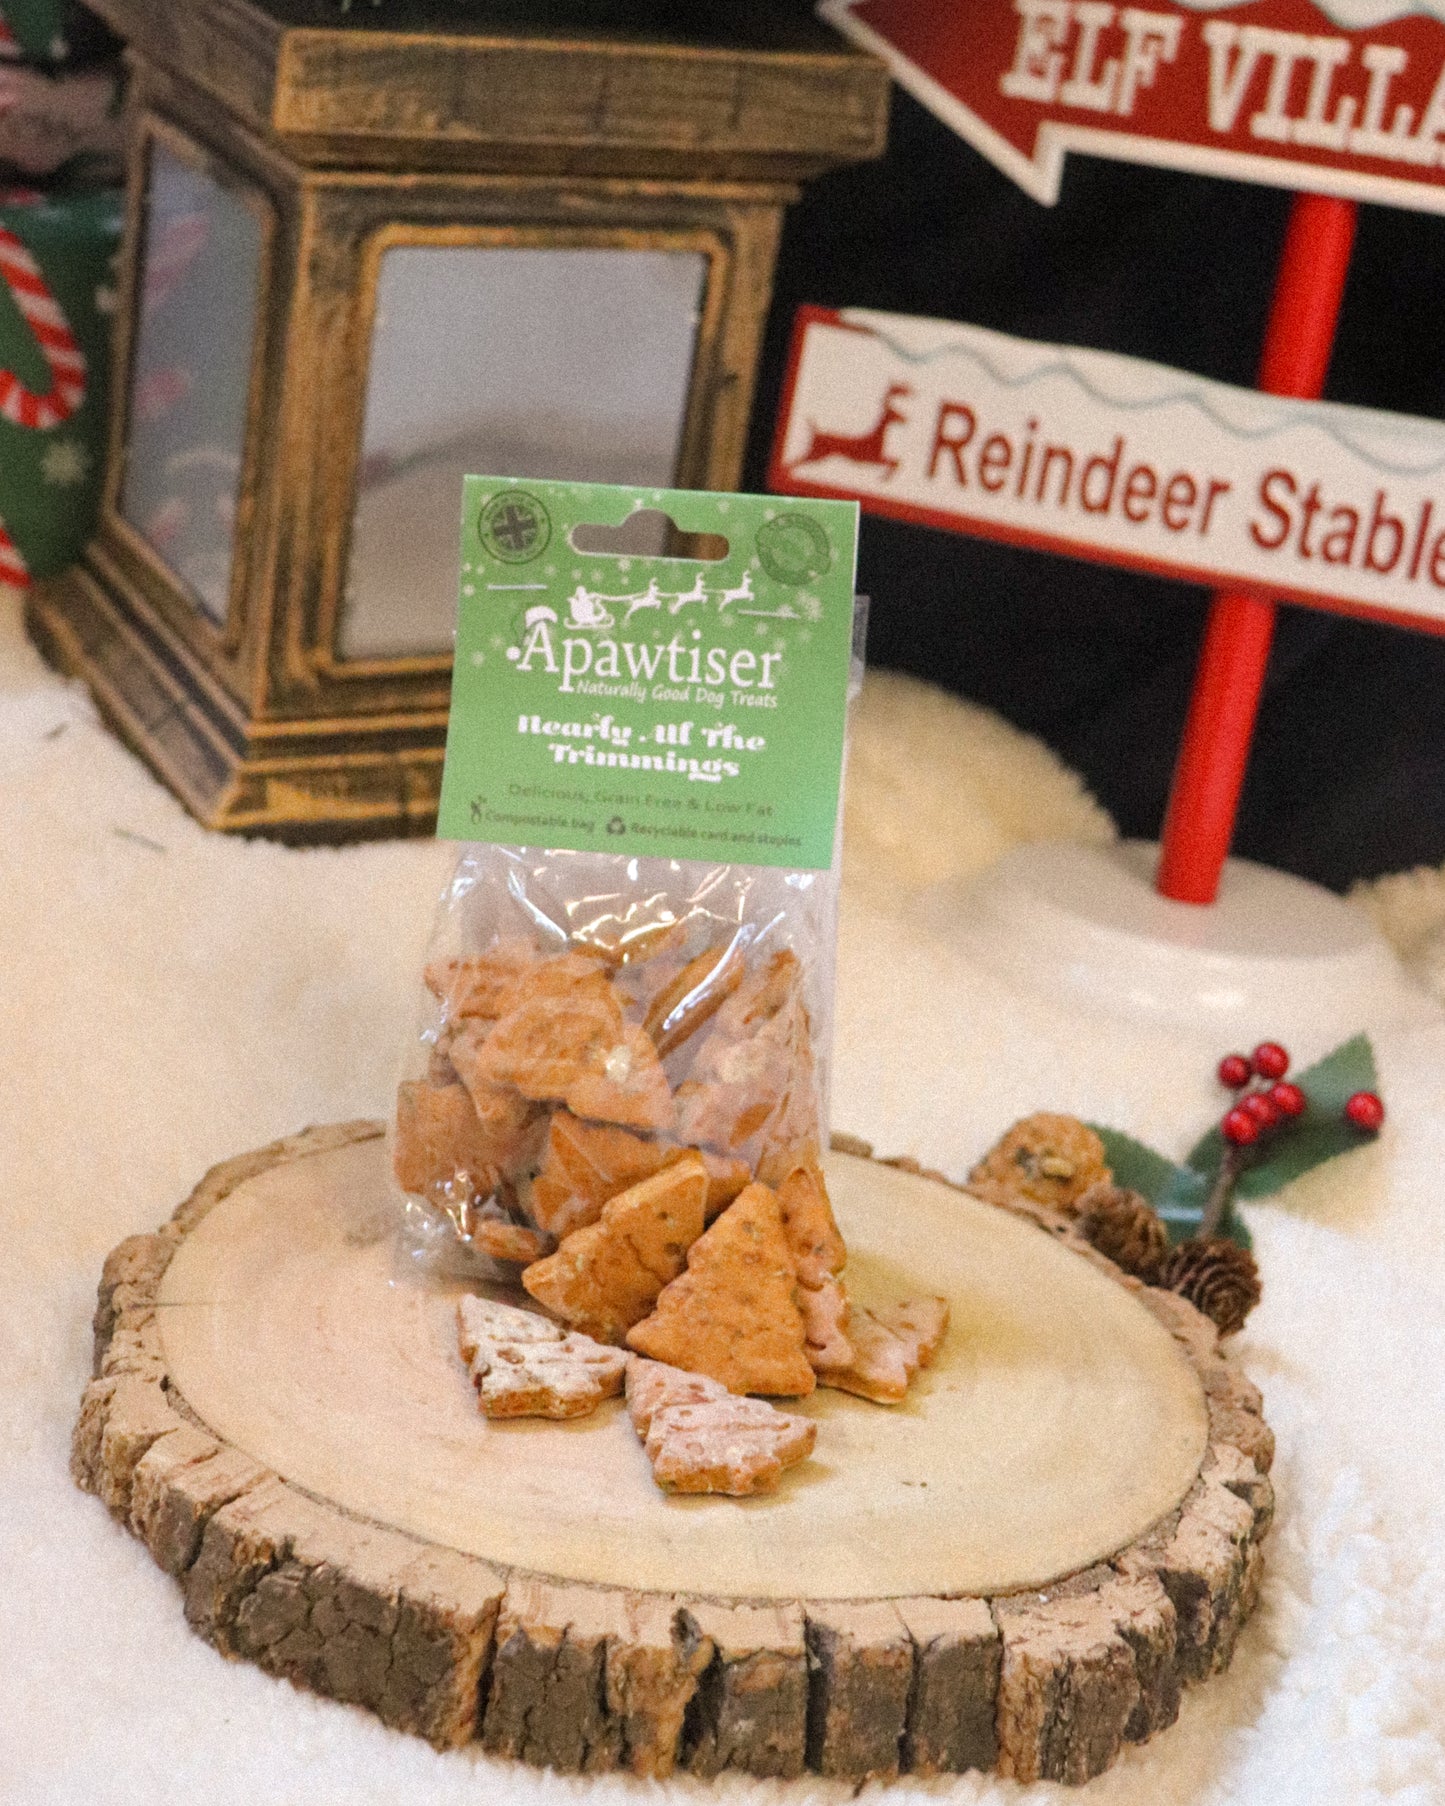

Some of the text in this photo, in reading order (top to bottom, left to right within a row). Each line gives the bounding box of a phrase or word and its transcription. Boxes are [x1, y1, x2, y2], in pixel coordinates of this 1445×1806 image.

[1000, 0, 1183, 116] ELF
[926, 400, 1232, 535] Reindeer
[516, 620, 782, 692] Apawtiser
[576, 680, 778, 709] Naturally Good Dog Treats
[518, 713, 632, 747] Nearly
[701, 721, 766, 751] The
[549, 743, 740, 782] Trimmings
[594, 790, 641, 806] Grain
[645, 793, 682, 810] Free
[704, 800, 742, 814] Low
[746, 802, 773, 818] Fat
